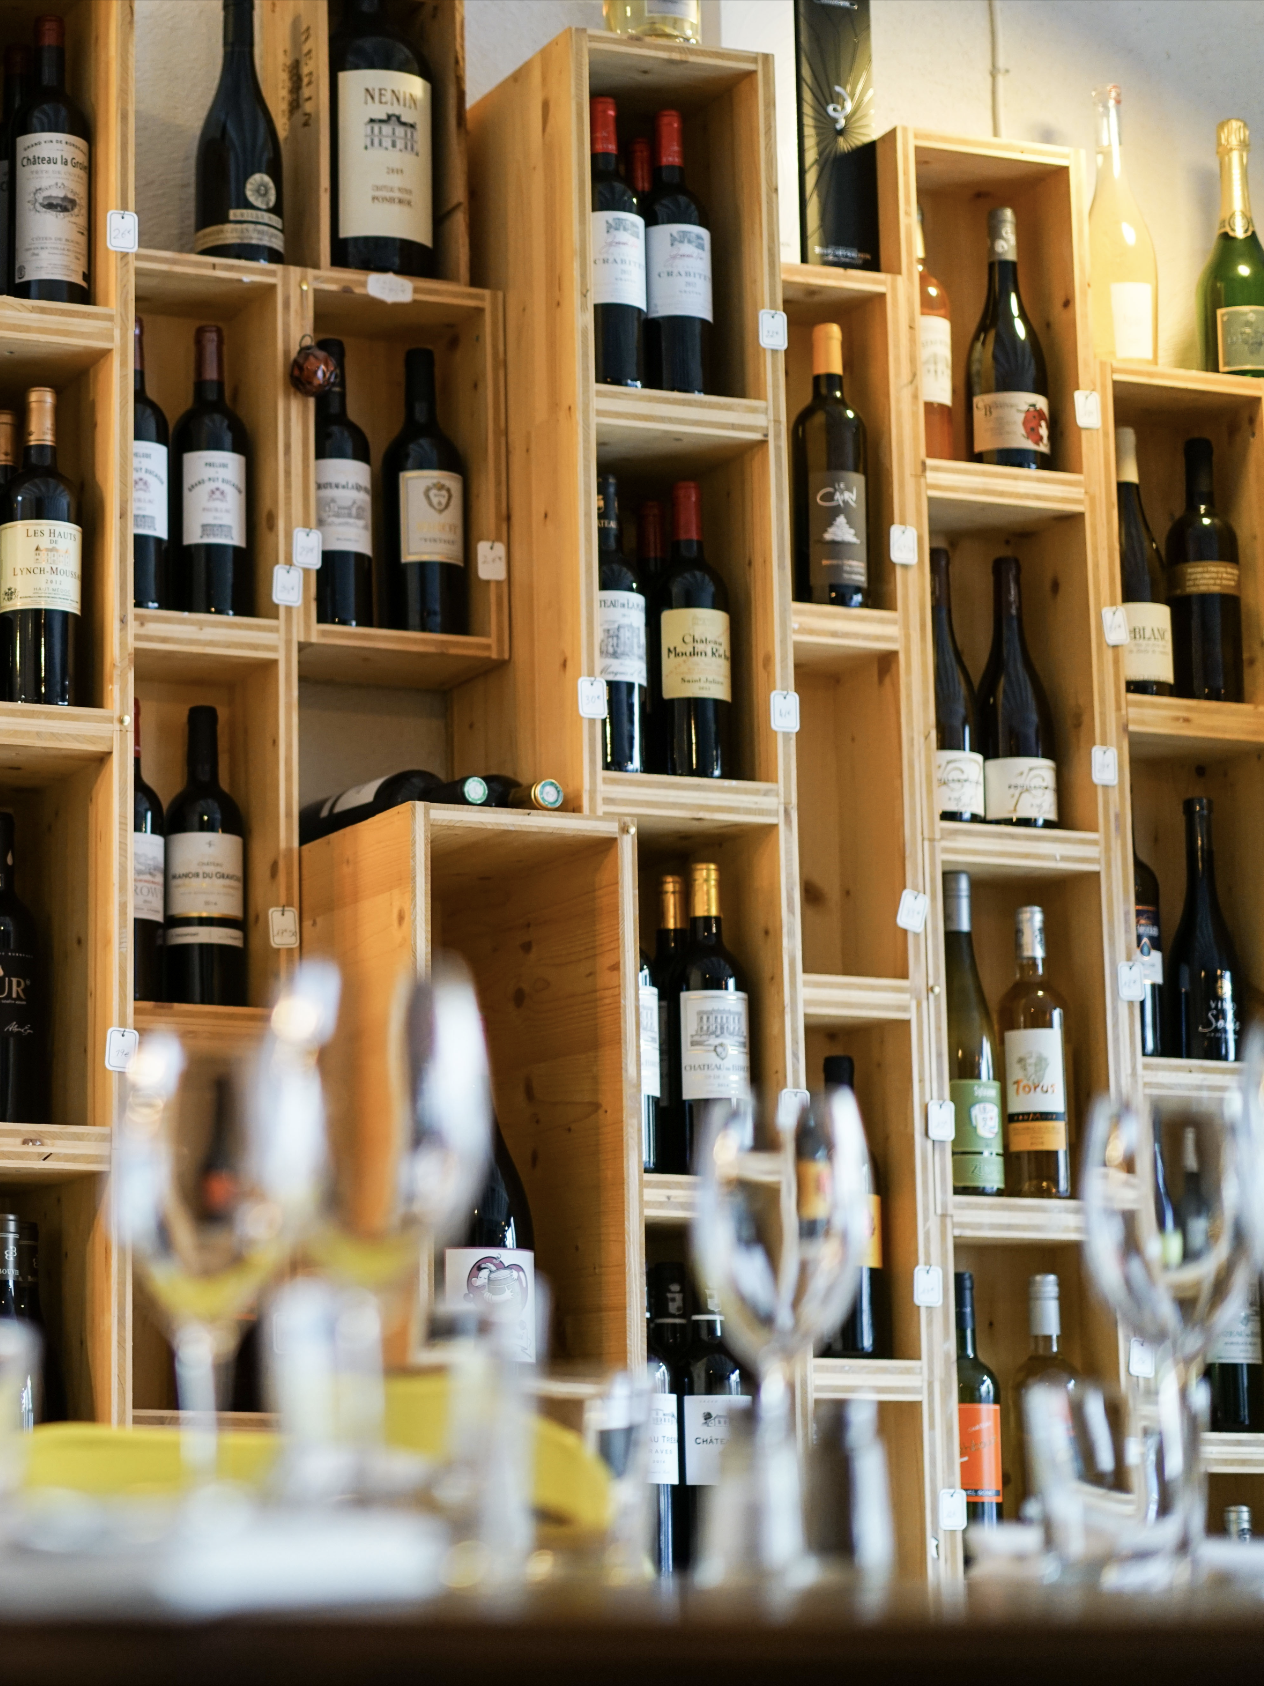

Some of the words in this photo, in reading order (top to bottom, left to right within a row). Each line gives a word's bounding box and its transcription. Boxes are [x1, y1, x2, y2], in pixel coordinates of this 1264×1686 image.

[364, 87, 418, 111] NENIN
[24, 141, 42, 151] GRAND
[21, 154, 58, 167] Château
[61, 155, 68, 166] la
[594, 257, 645, 271] CRABITE
[26, 528, 45, 538] LES
[48, 528, 77, 542] HAUTS
[13, 566, 80, 581] LYNCH-MOUSSA
[667, 647, 707, 660] Moulin
[1013, 1077, 1057, 1097] Torus
